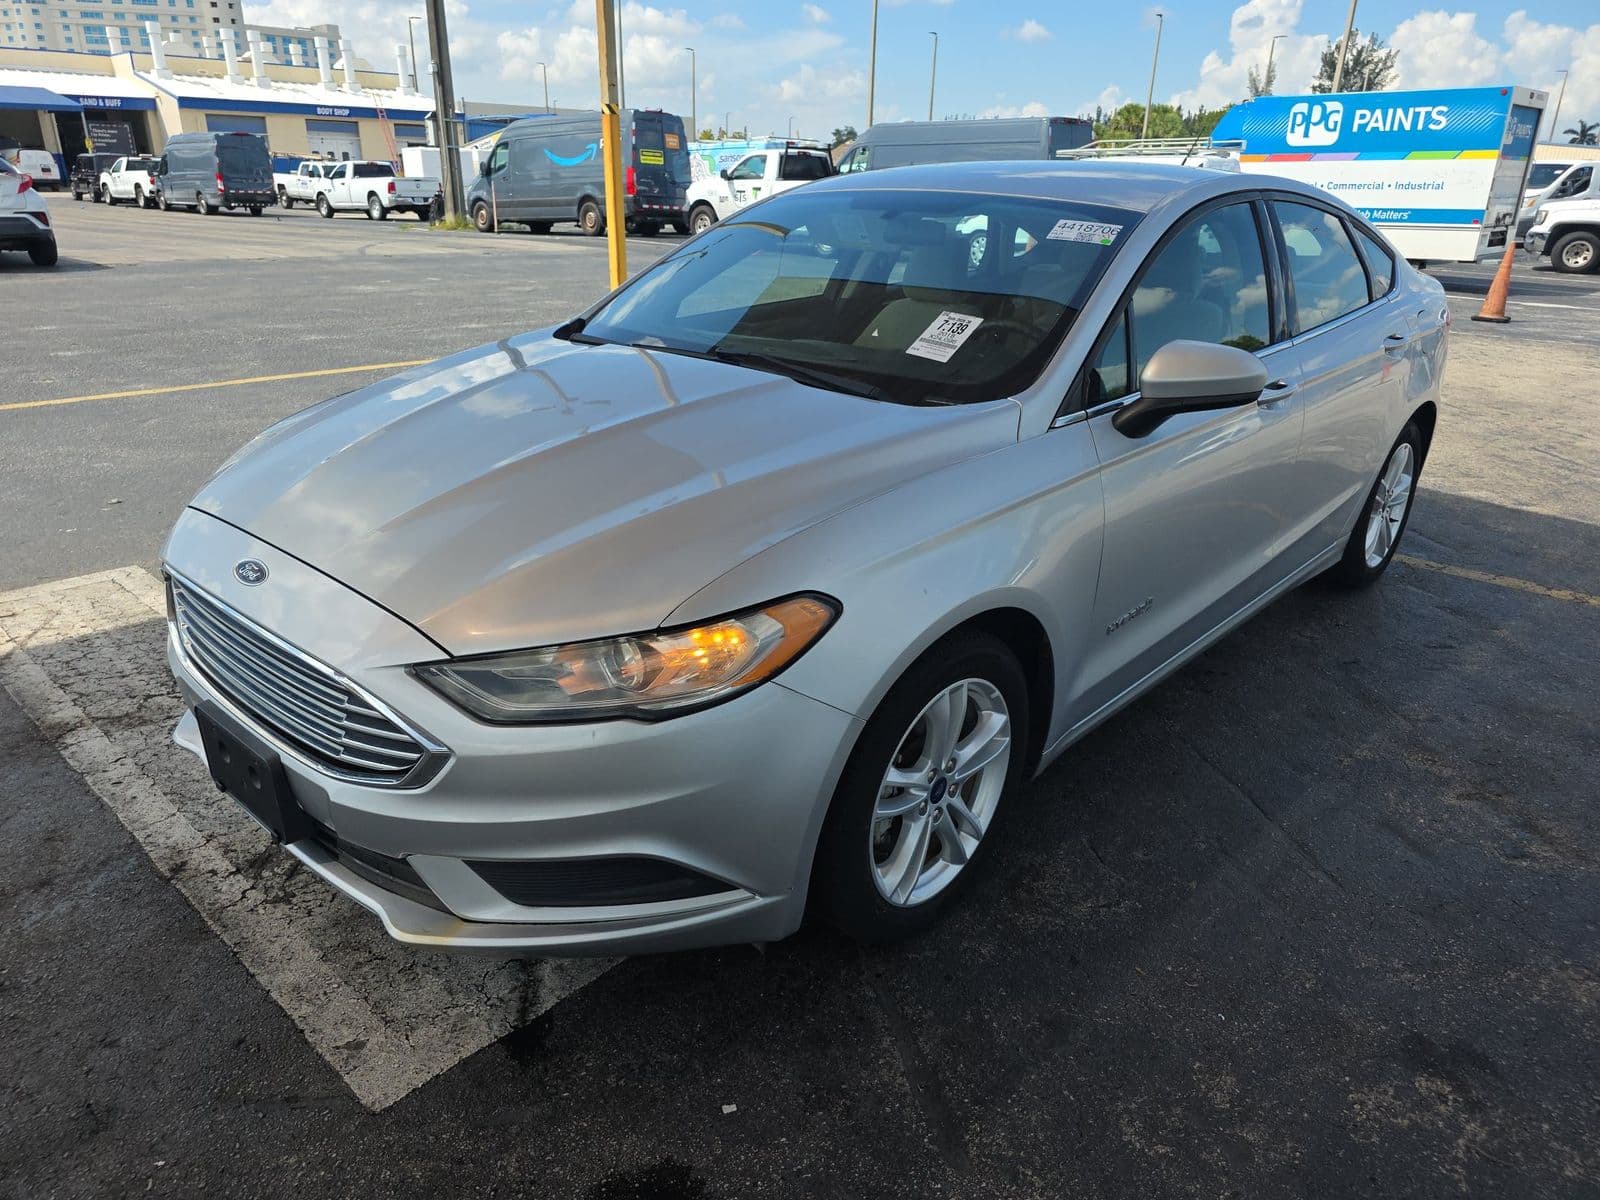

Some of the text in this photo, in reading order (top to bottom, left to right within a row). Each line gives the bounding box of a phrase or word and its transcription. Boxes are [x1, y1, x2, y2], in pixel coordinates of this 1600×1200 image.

[80, 98, 97, 106] SAND
[105, 99, 121, 107] BUFF
[316, 107, 350, 116] BODY SHOP
[1289, 101, 1448, 139] PPG PAINTS
[1326, 181, 1384, 190] Commercial
[1394, 181, 1444, 190] Industrial
[239, 562, 261, 580] Ford
